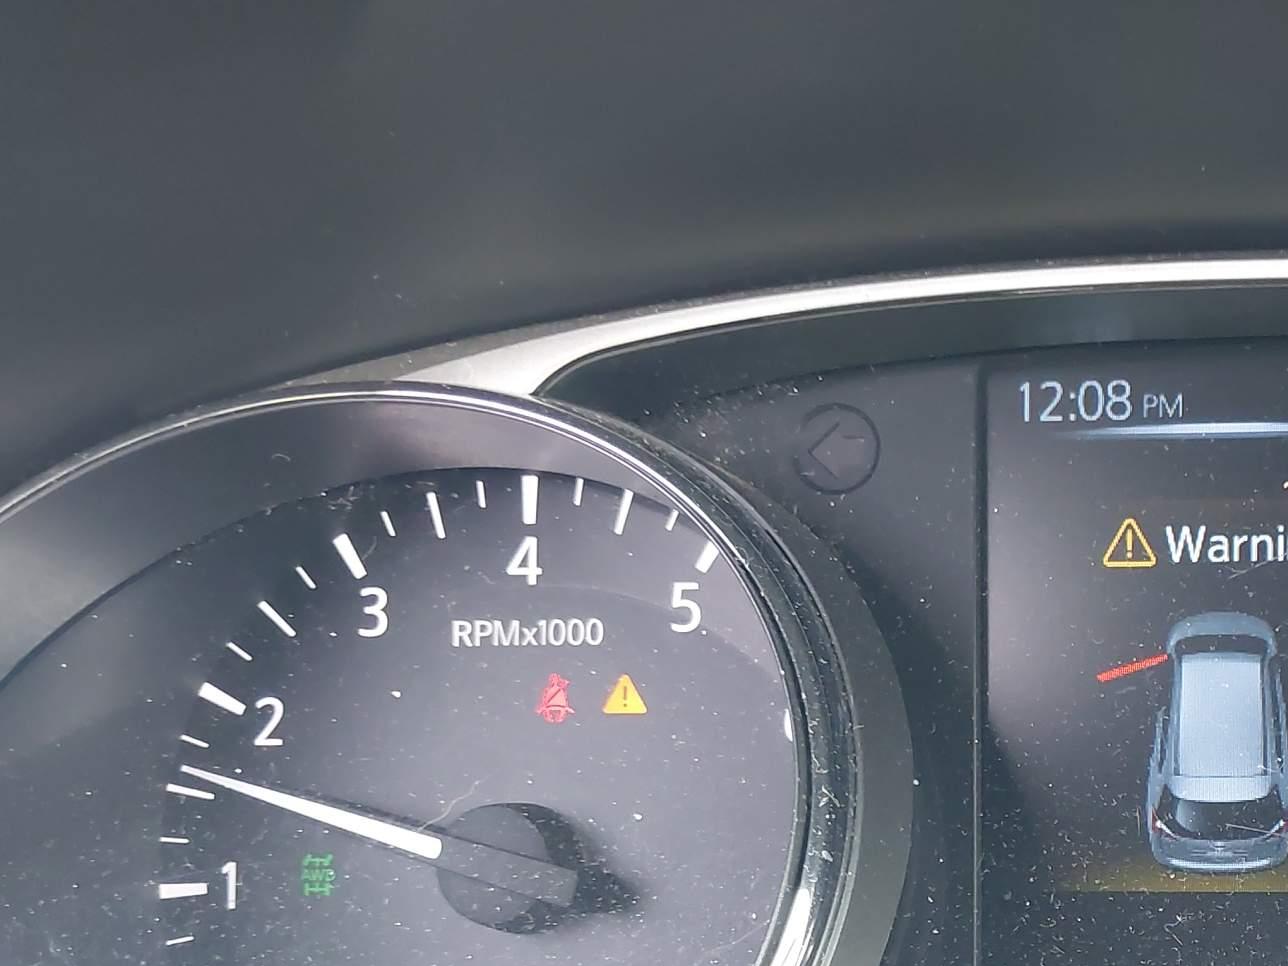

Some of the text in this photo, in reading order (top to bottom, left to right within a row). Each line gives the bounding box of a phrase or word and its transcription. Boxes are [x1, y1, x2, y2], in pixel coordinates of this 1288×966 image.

[1020, 380, 1182, 422] 12:08 PM
[506, 536, 542, 585] 4
[358, 587, 387, 637] 3
[671, 582, 701, 632] 5
[452, 618, 603, 647] RPMx1000
[254, 697, 283, 745] 2
[222, 862, 236, 909] 1
